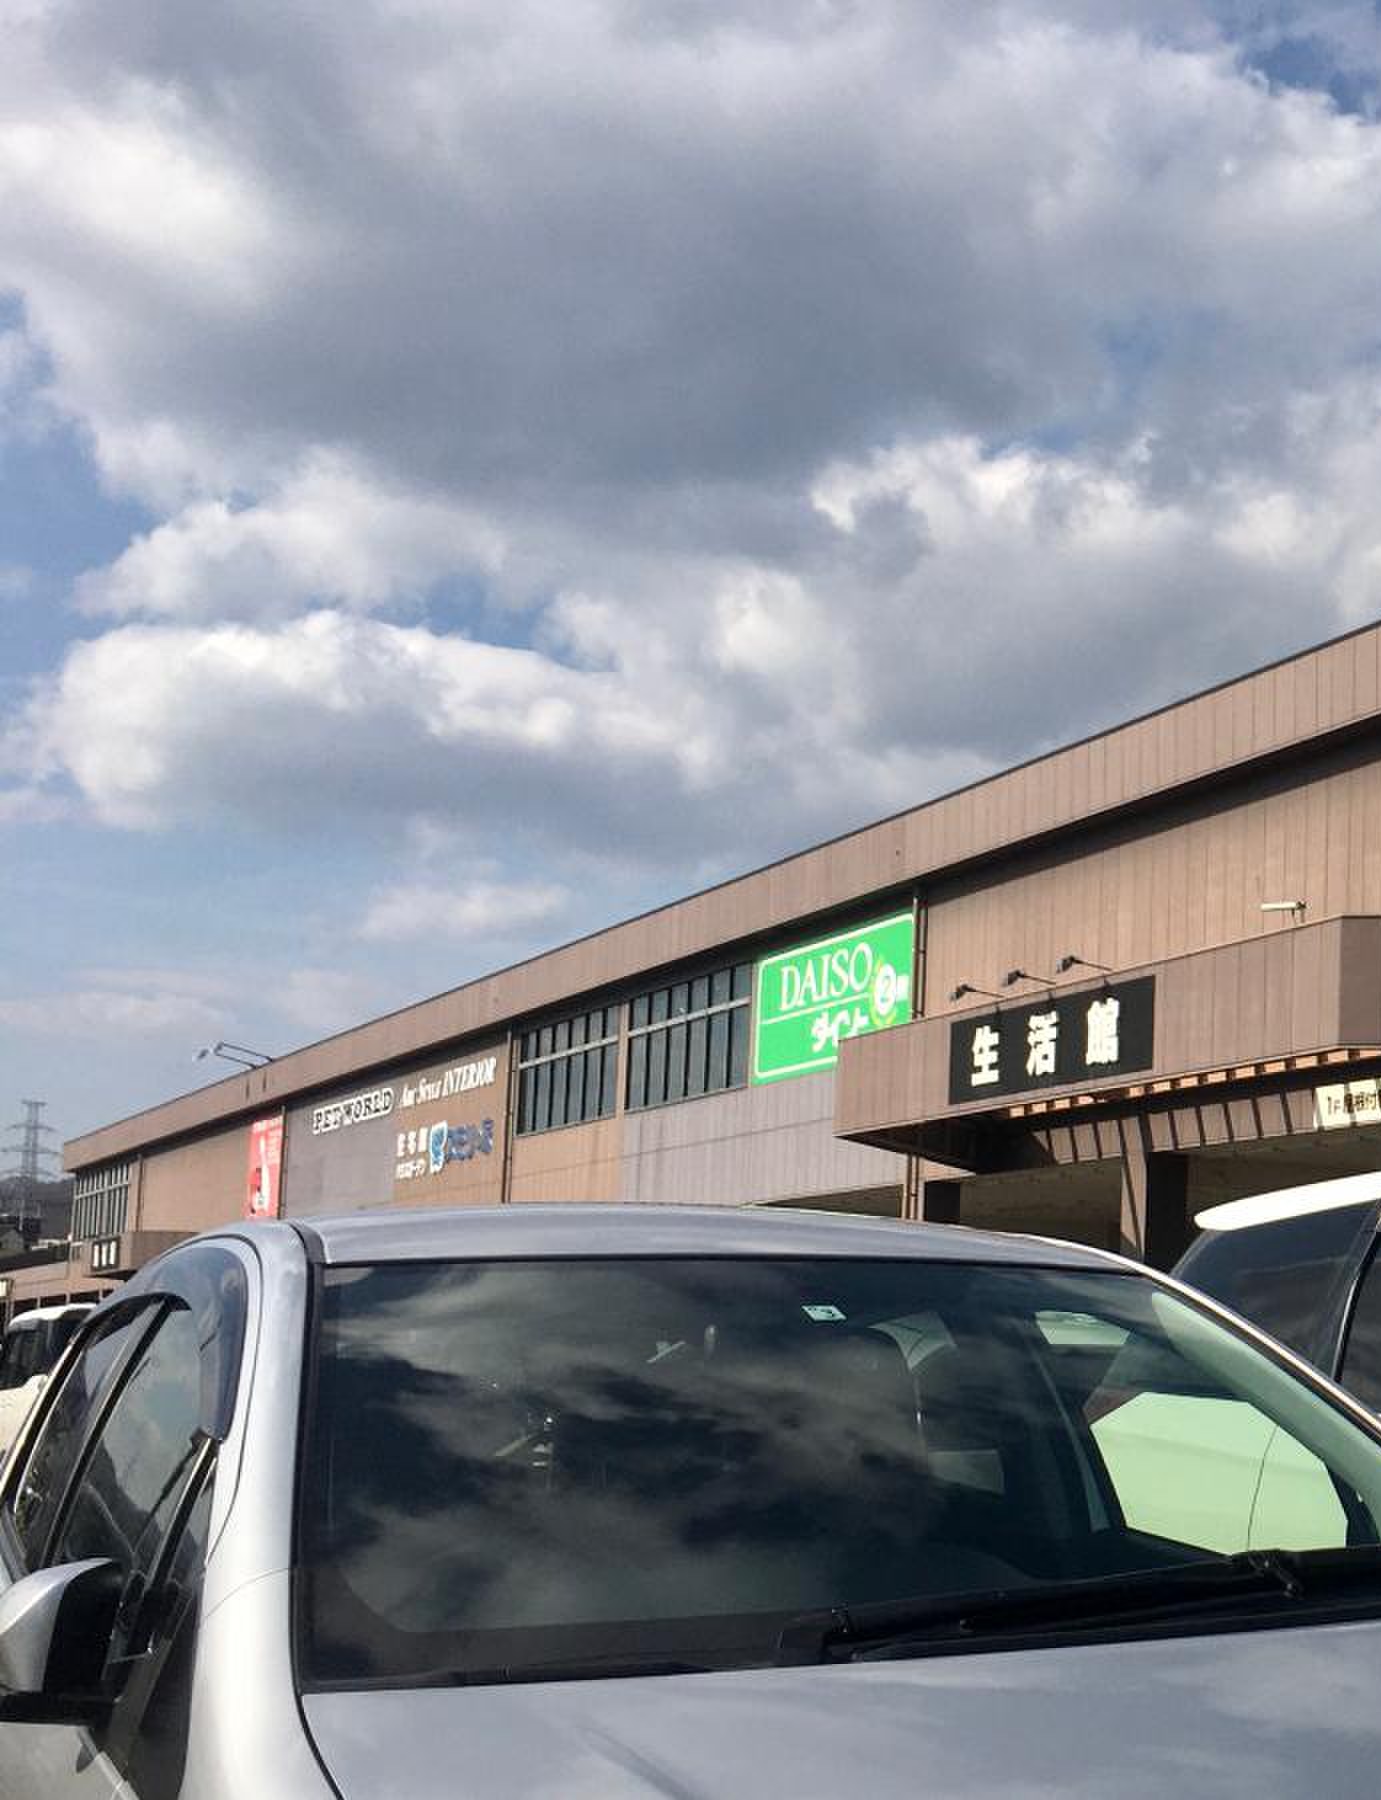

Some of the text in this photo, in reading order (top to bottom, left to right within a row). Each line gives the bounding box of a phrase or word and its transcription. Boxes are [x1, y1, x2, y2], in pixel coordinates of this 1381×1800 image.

[778, 942, 873, 1011] DAISO
[971, 997, 1119, 1086] 生活館
[442, 1056, 497, 1097] INTERIOR
[313, 1088, 394, 1135] PET WORLD
